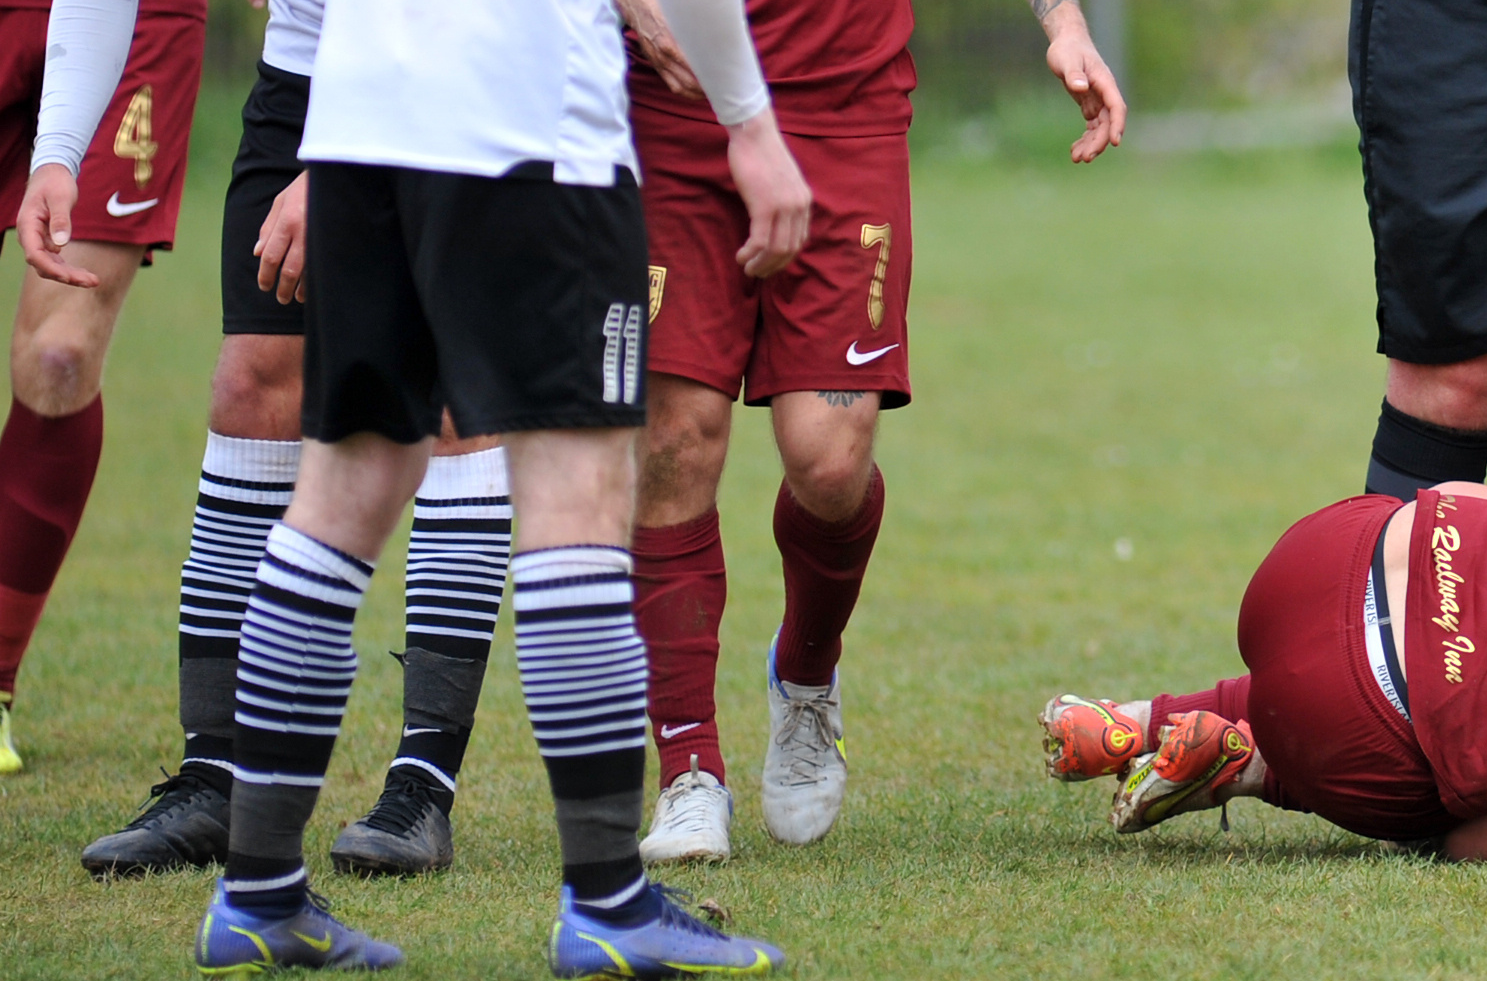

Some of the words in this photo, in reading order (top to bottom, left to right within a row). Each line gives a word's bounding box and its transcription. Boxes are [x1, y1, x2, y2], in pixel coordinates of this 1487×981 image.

[113, 84, 159, 190] 4
[860, 222, 892, 330] 7
[603, 302, 641, 405] 11
[1432, 524, 1465, 633] Railway
[1376, 664, 1396, 698] RIVER
[1442, 635, 1476, 684] Inn
